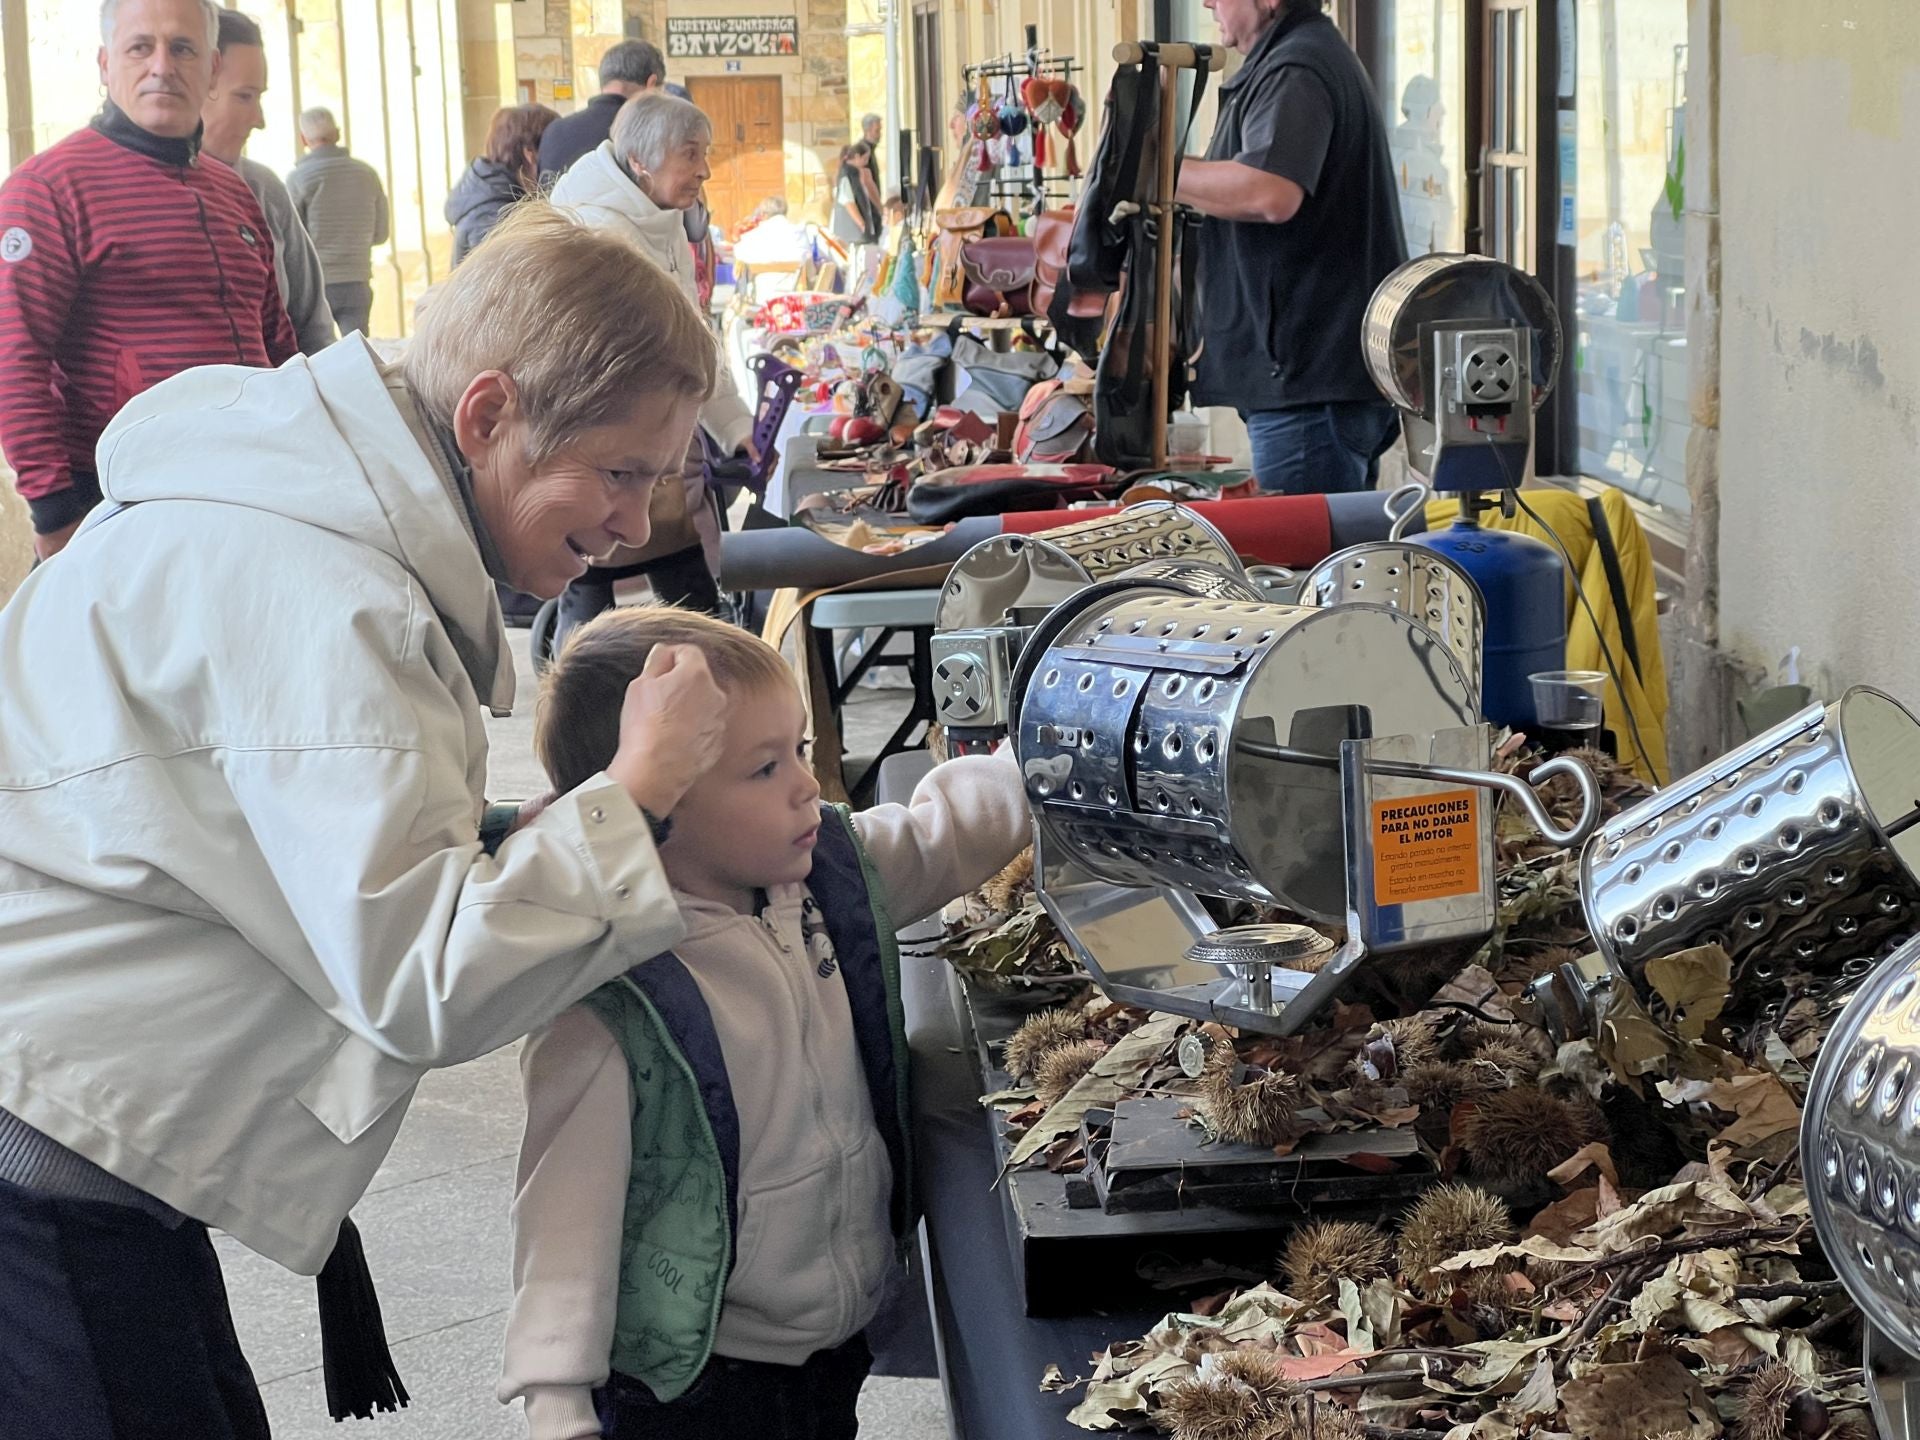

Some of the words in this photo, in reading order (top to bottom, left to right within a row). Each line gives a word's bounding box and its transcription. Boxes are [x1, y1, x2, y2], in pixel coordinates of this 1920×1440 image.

[1382, 800, 1469, 821] PRECAUCIONES
[1382, 821, 1410, 834] PARA
[1413, 819, 1429, 829] NO
[1400, 834, 1411, 844] EL
[1414, 828, 1453, 842] MOTOR
[1410, 847, 1435, 859] parado
[1389, 873, 1416, 885] Estando
[1429, 869, 1455, 880] marcha
[1456, 868, 1466, 876] no
[648, 1250, 685, 1295] COOL
